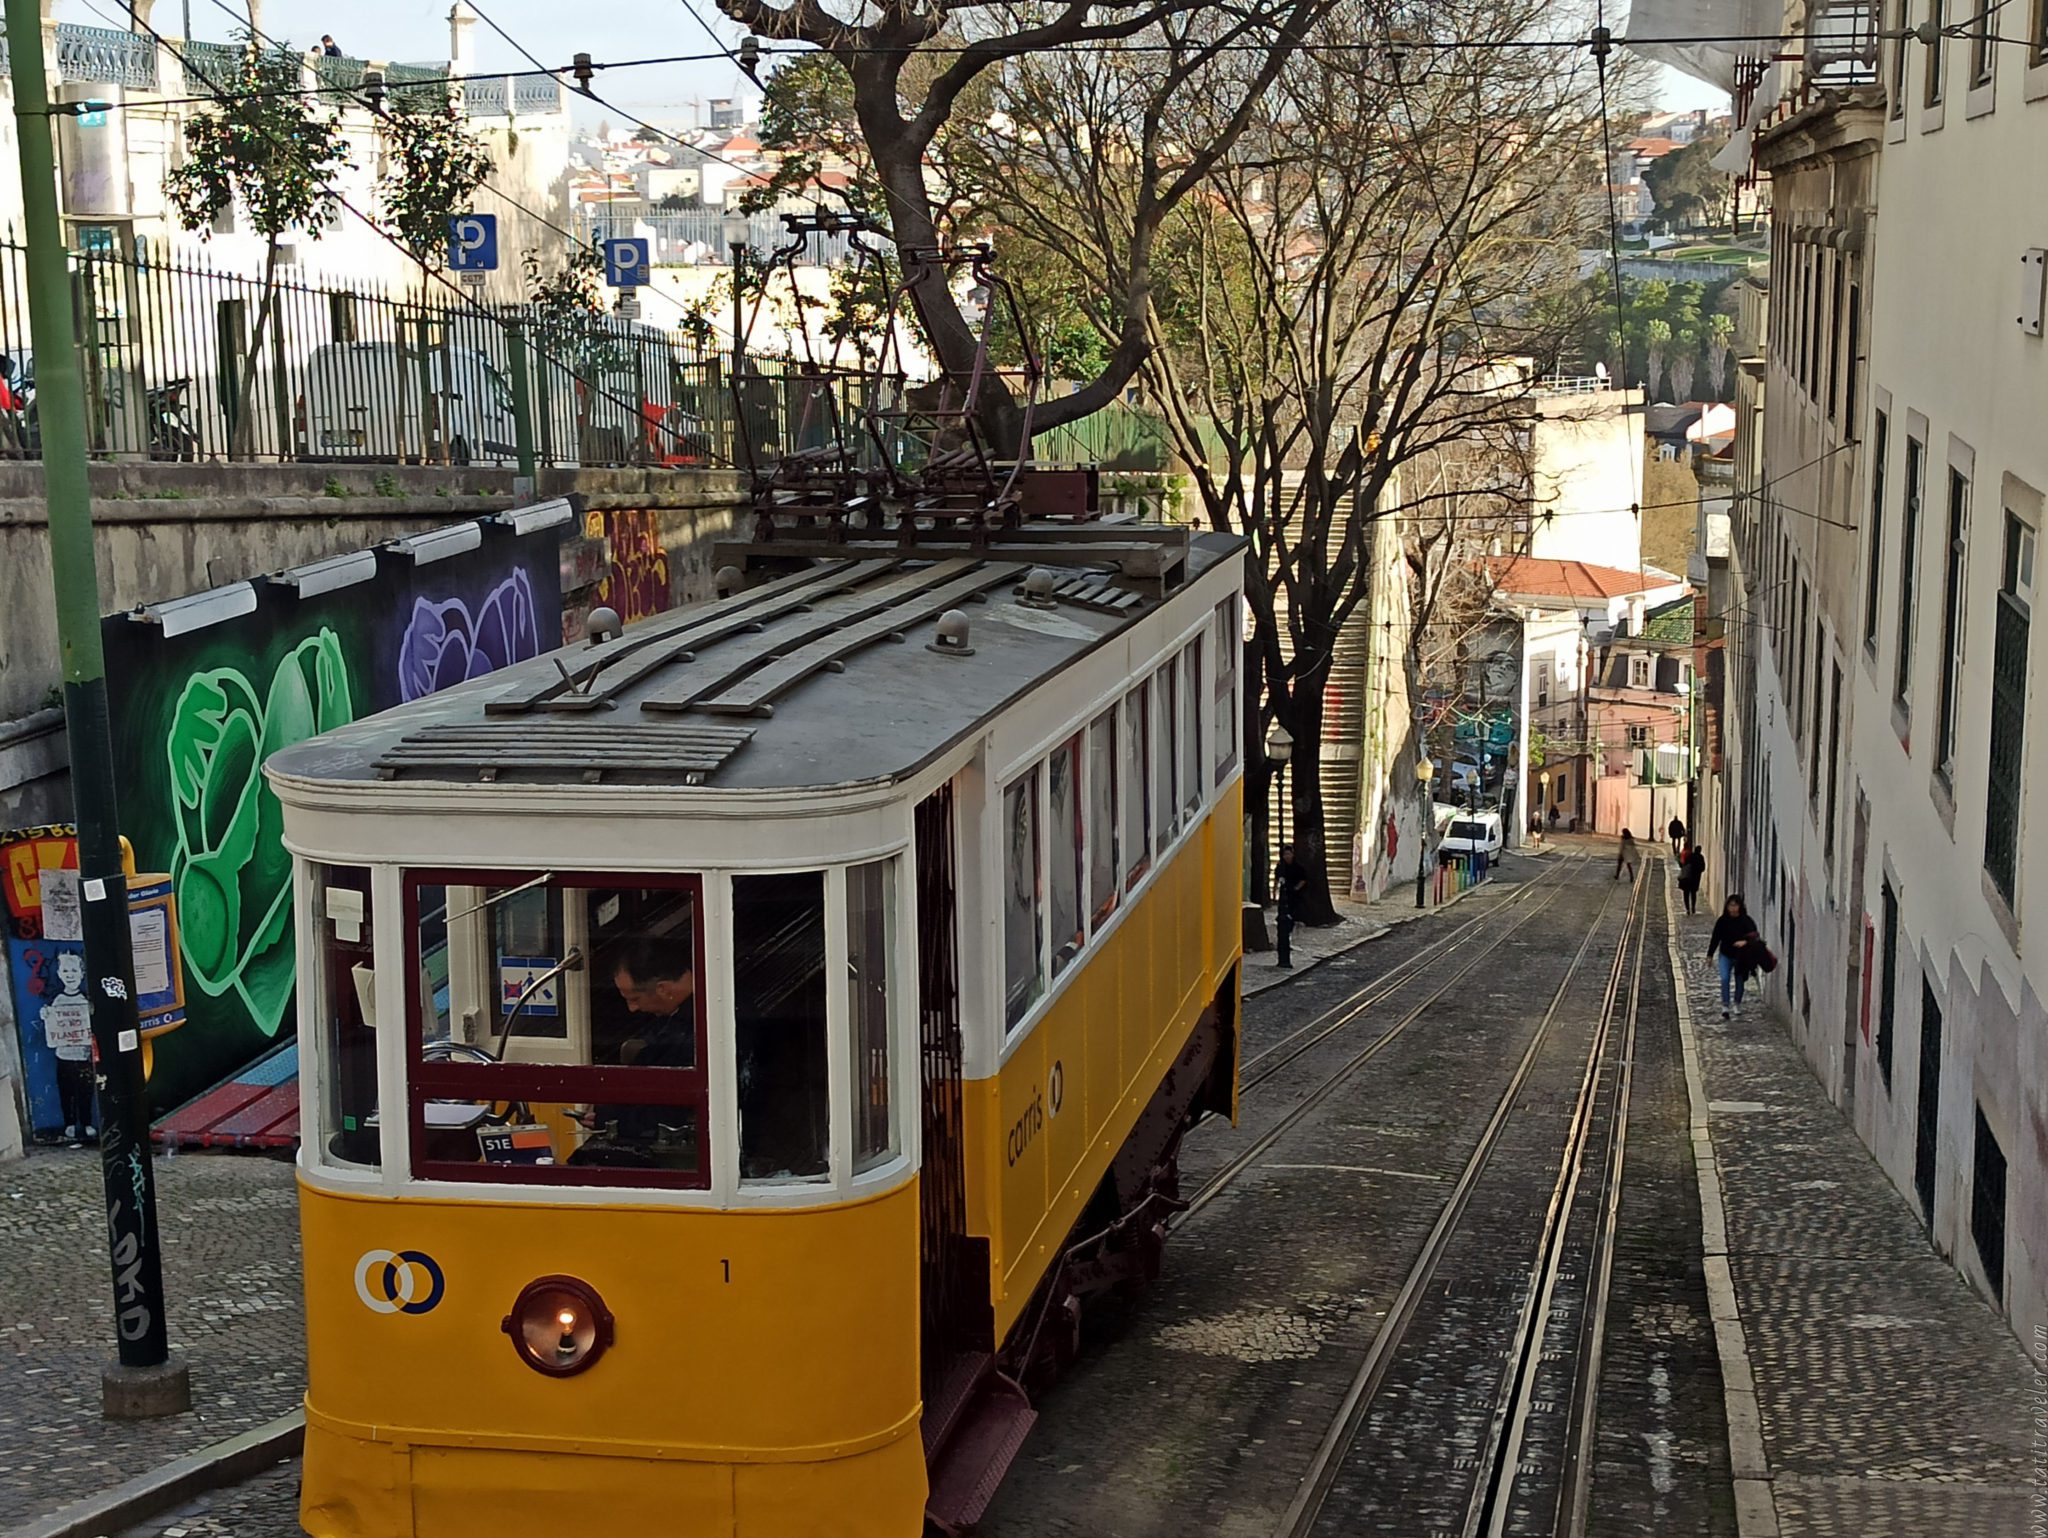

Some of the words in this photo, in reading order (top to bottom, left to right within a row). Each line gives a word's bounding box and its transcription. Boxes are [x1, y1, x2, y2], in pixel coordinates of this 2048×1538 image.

[457, 219, 486, 265] P
[614, 243, 639, 283] P
[50, 1029, 85, 1041] PLANET
[69, 1018, 82, 1027] NO
[1008, 1084, 1043, 1168] carris
[486, 1138, 511, 1150] 51E
[721, 1258, 729, 1283] 1
